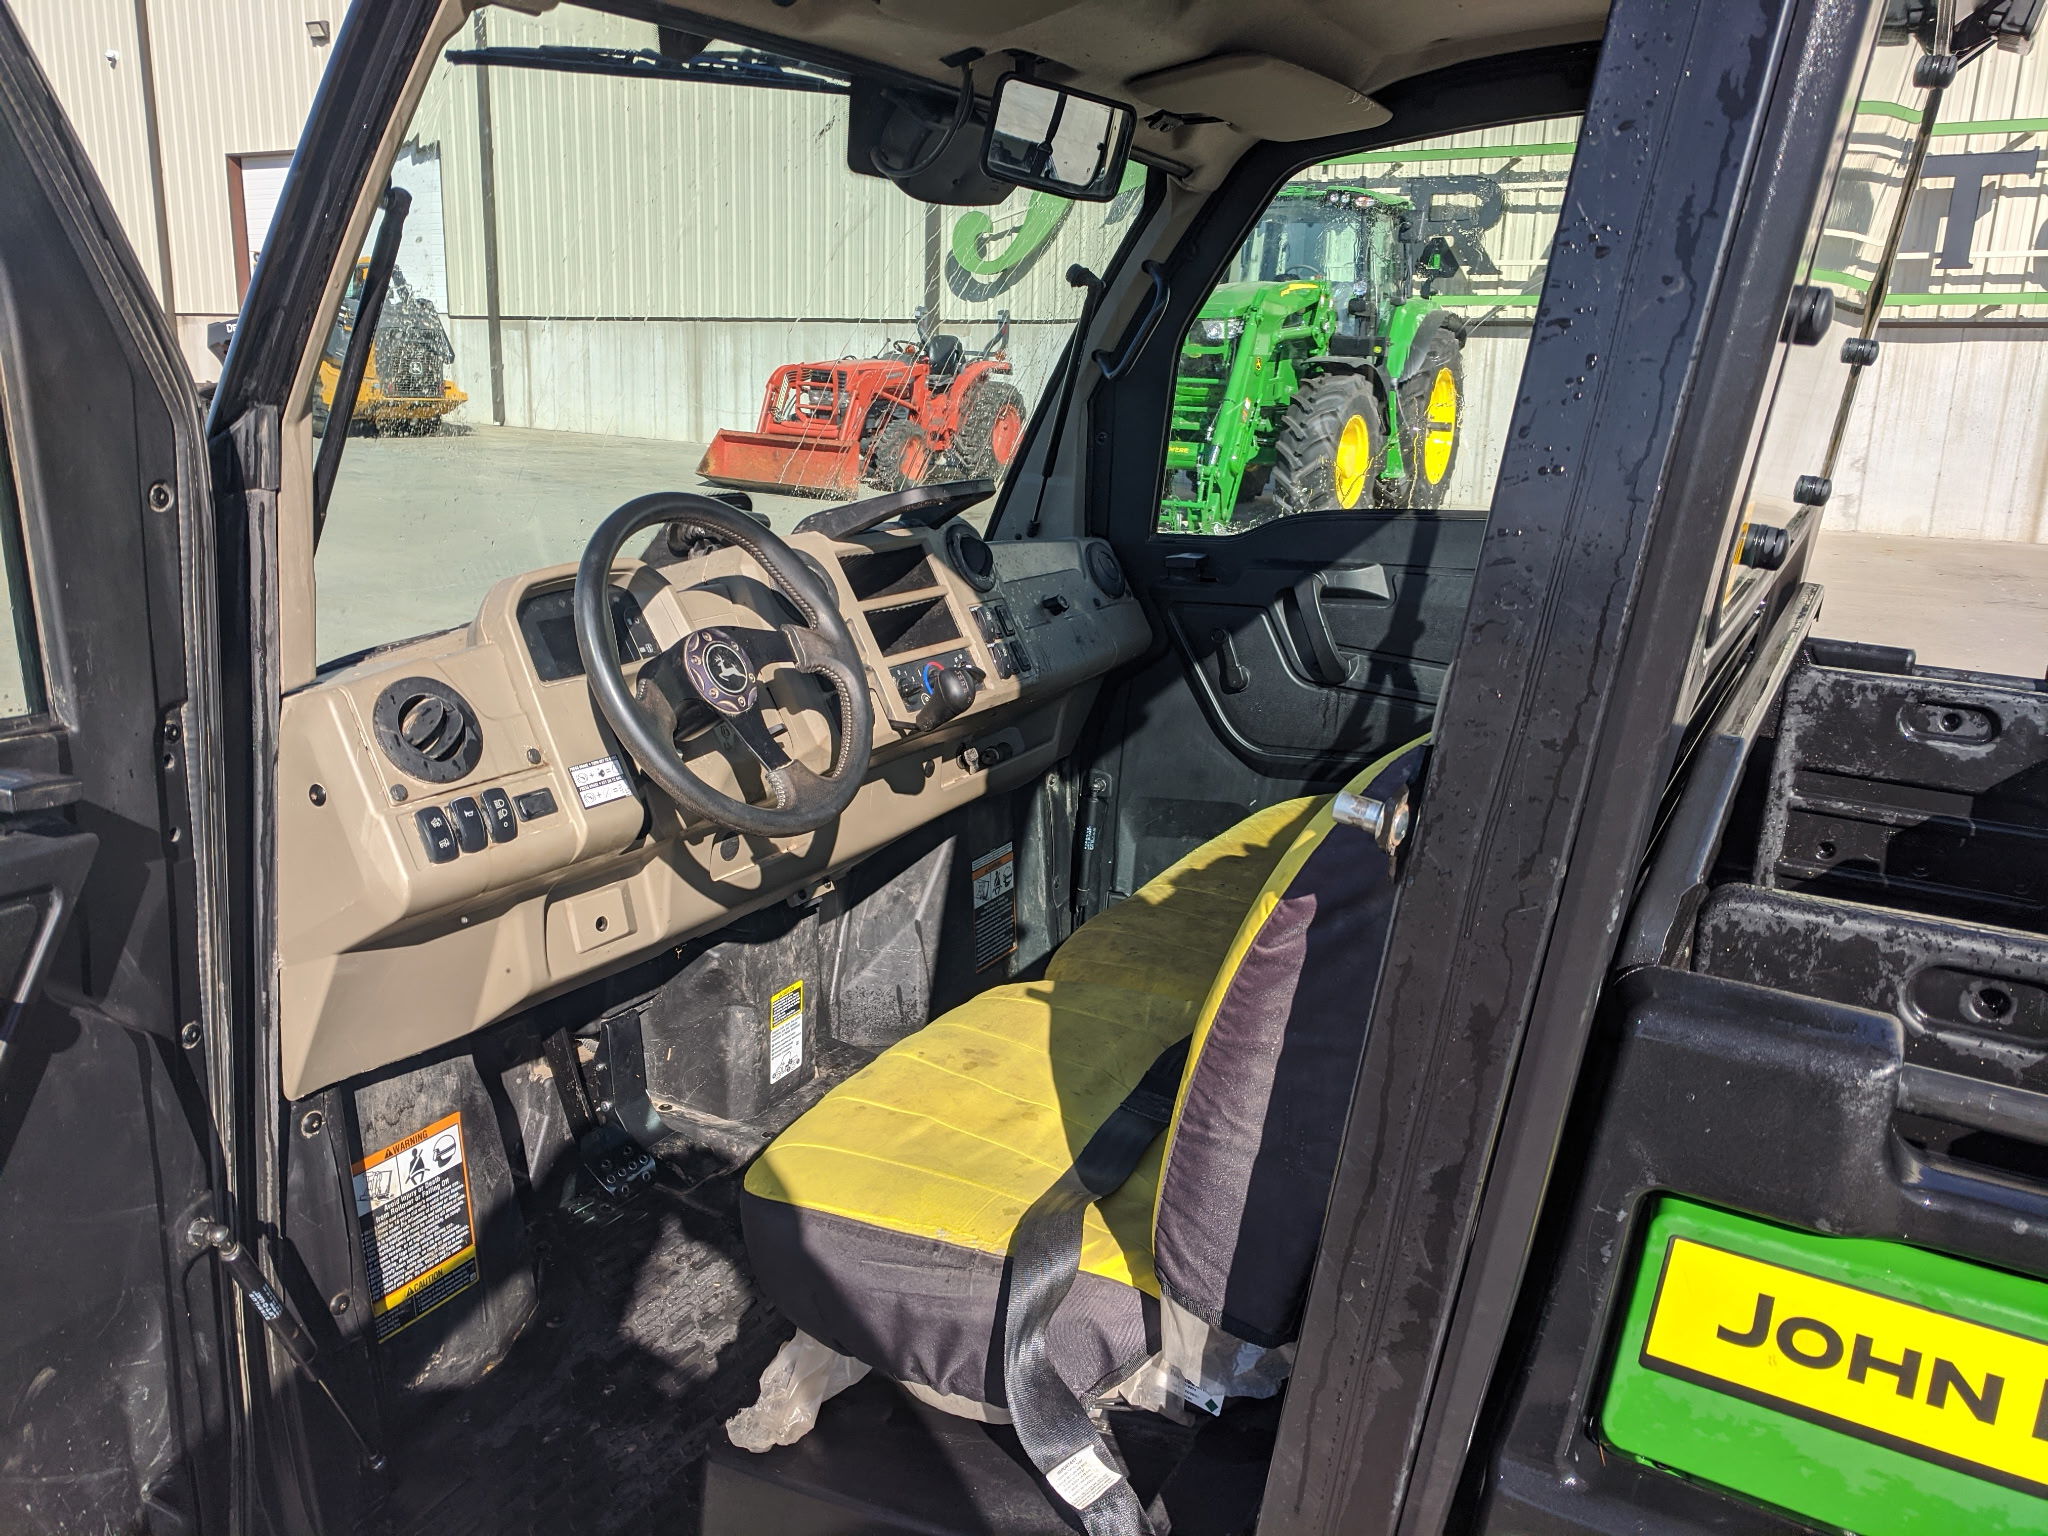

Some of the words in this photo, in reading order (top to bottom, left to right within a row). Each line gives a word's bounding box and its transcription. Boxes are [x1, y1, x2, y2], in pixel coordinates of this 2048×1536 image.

[393, 1130, 428, 1155] WARNING
[375, 1210, 389, 1223] from
[390, 1196, 413, 1215] Rollover
[421, 1182, 440, 1198] Falling
[383, 1197, 400, 1211] Avoid
[400, 1188, 416, 1203] Injury
[417, 1185, 423, 1193] or
[424, 1175, 440, 1189] Death
[413, 1268, 443, 1293] CAUTION
[1716, 1293, 2006, 1426] JOHN
